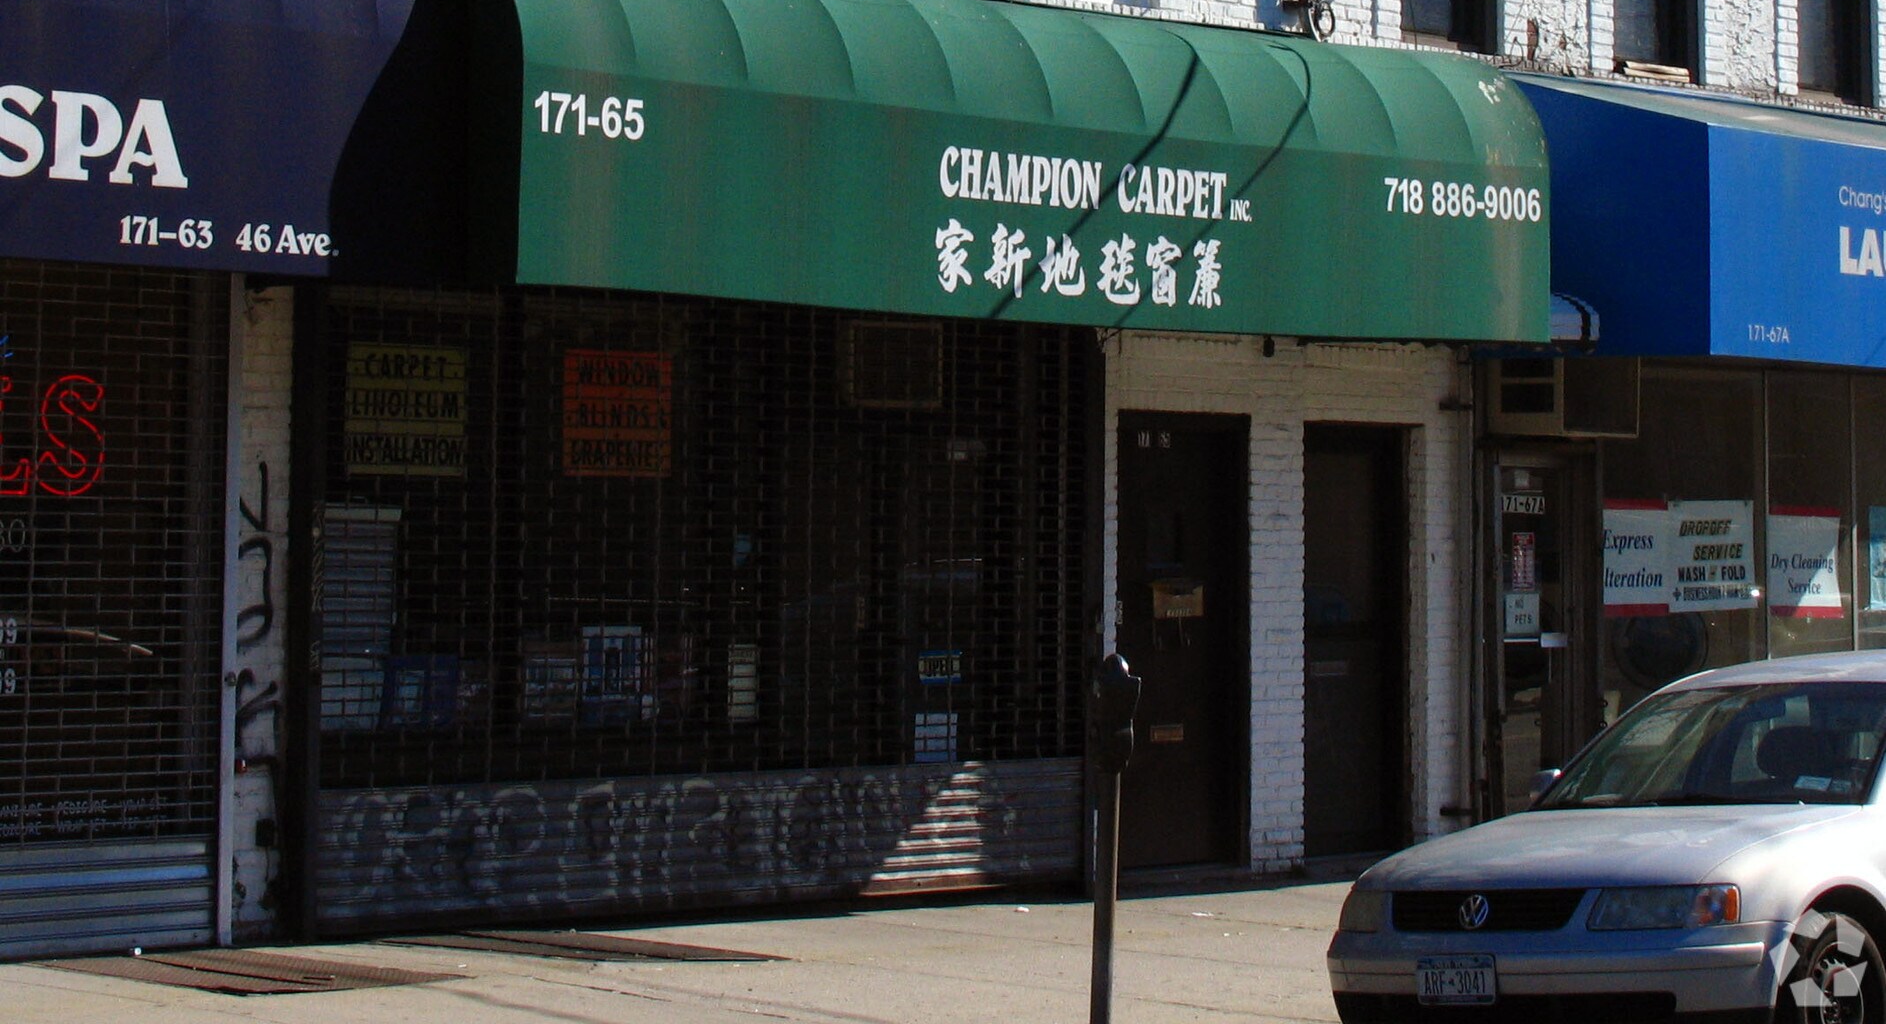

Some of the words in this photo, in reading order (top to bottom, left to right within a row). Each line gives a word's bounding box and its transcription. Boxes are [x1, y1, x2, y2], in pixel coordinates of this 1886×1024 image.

[534, 90, 645, 141] 171-65
[0, 84, 188, 189] SPA
[939, 145, 1102, 210] CHAMPION
[1117, 163, 1228, 220] CARPET
[1229, 198, 1253, 223] INC.
[1383, 177, 1424, 216] 718
[1431, 181, 1542, 223] 886-9006
[1838, 185, 1886, 215] Chang'
[119, 215, 214, 249] 171-63
[235, 222, 272, 253] 46
[1839, 225, 1886, 278] LA
[1747, 323, 1791, 344] 171-67A
[366, 352, 447, 382] CARPET
[351, 388, 459, 419] LINOLEUM
[1602, 528, 1654, 555] Express
[1678, 519, 1732, 537] DROPOFF
[1692, 543, 1744, 561] SERVICE
[1770, 553, 1788, 573] Dry
[1791, 553, 1834, 574] Cleaning
[1604, 567, 1663, 588] lteration
[1677, 565, 1706, 582] WASH
[1720, 565, 1746, 581] FOLD
[1787, 578, 1822, 594] Service
